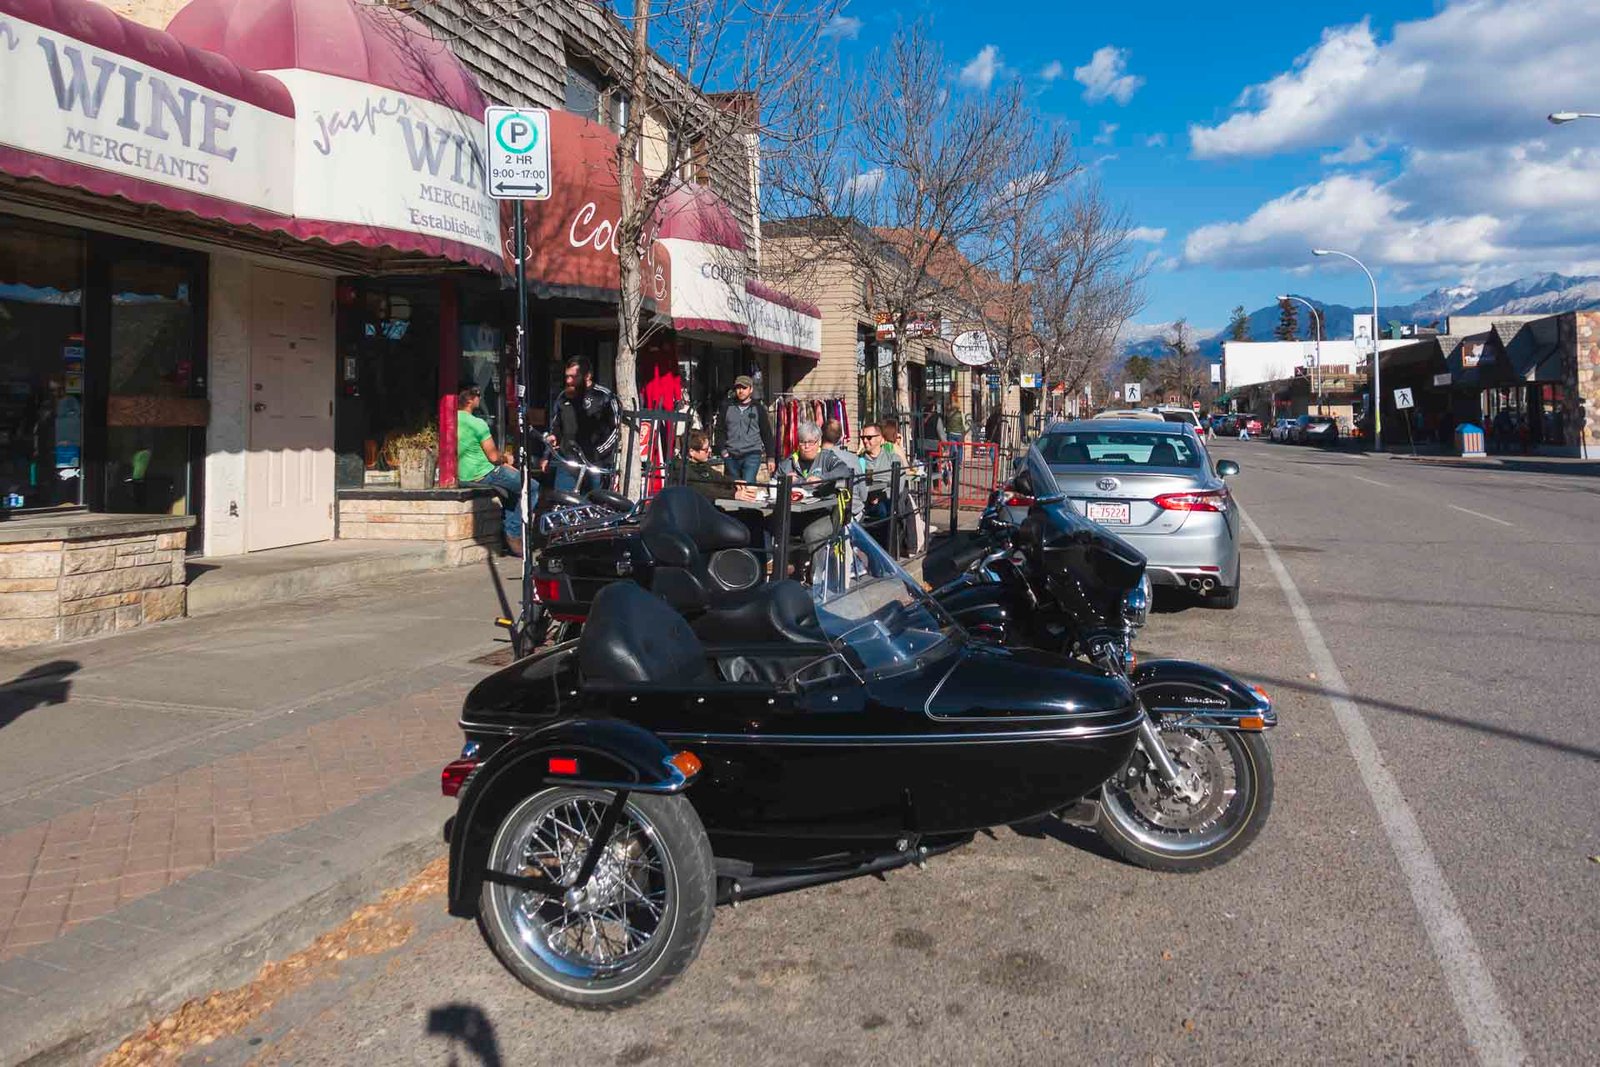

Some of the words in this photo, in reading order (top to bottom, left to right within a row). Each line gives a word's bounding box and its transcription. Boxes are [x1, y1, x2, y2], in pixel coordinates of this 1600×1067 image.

[37, 35, 237, 162] WINE
[313, 96, 411, 156] jasper
[63, 126, 209, 186] MERCHANTS
[397, 116, 487, 196] WIN
[505, 155, 512, 165] 2
[516, 155, 533, 165] HR
[511, 122, 528, 143] P
[408, 207, 481, 240] Established
